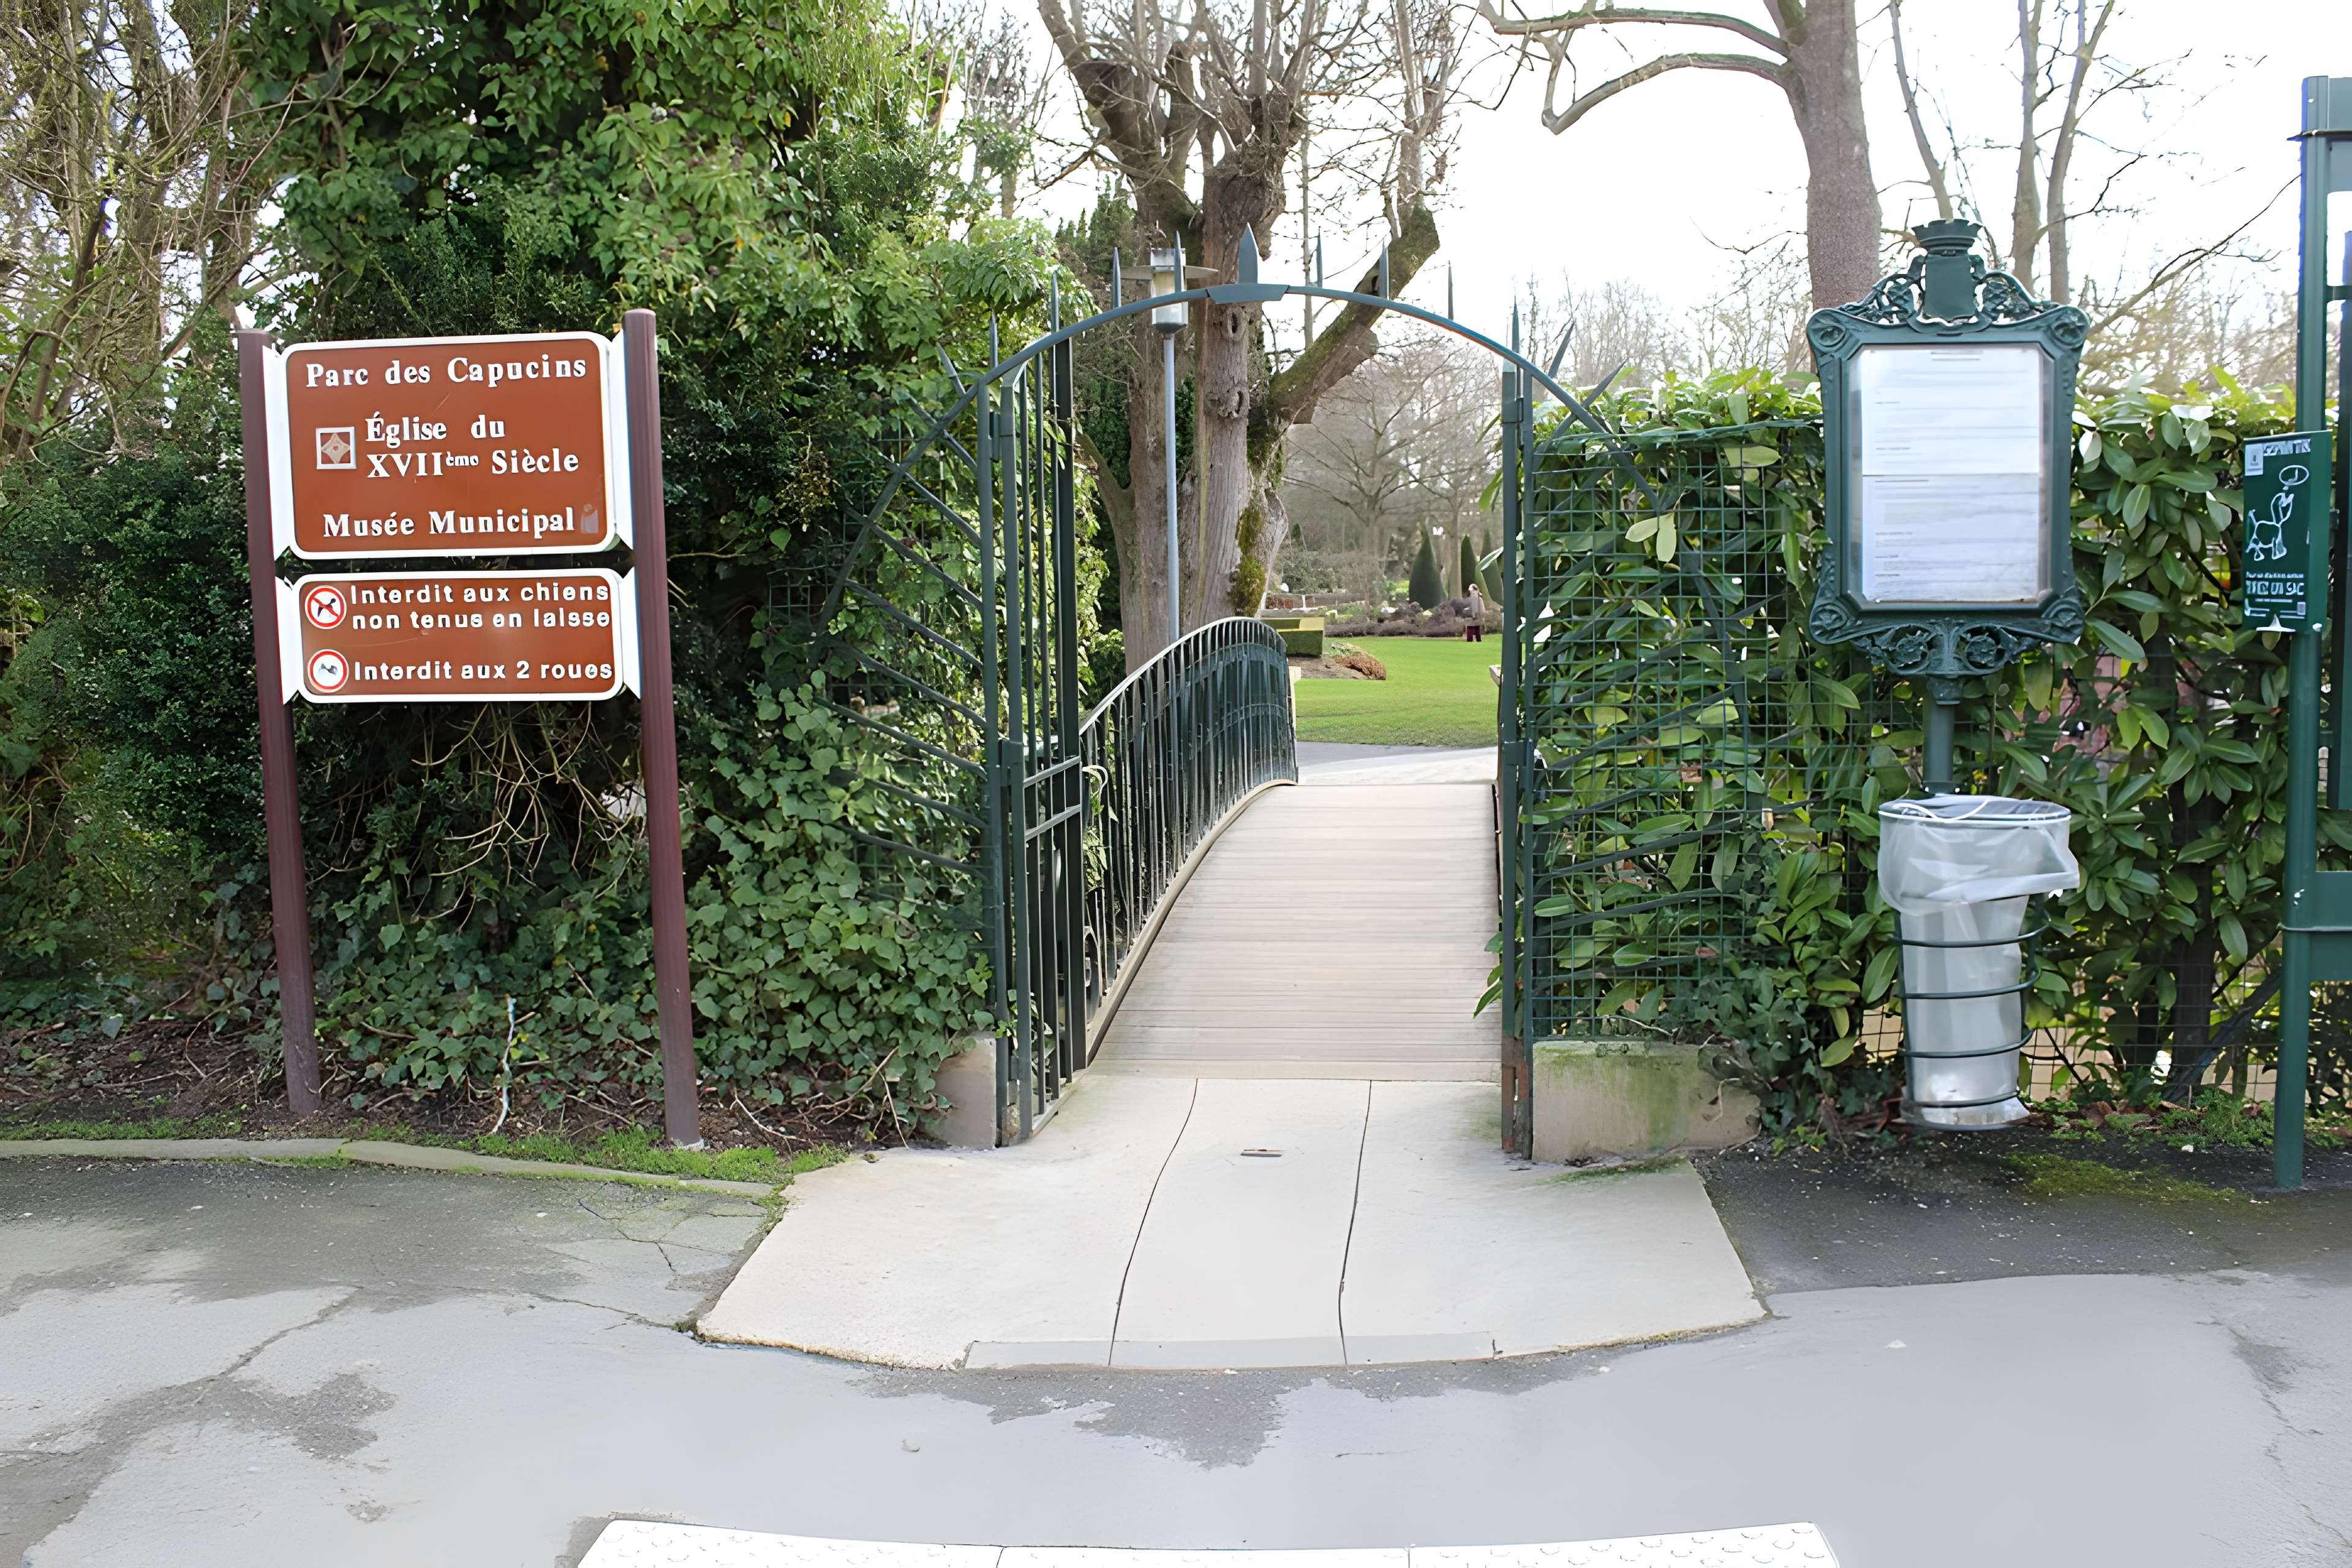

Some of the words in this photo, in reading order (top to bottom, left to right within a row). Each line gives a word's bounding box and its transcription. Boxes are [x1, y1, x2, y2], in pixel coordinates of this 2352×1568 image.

[306, 363, 368, 387] Parc
[385, 360, 431, 384] des
[447, 353, 586, 387] Capucins
[365, 411, 447, 448] Église
[470, 414, 505, 439] du
[492, 448, 579, 475] Siècle
[323, 511, 415, 537] Musée
[428, 507, 575, 539] Municipal
[350, 584, 454, 605] Interdit
[463, 587, 510, 603] aux
[521, 582, 609, 601] chiens
[352, 614, 400, 630] non
[410, 611, 481, 628] tenus
[492, 612, 522, 628] en
[533, 607, 611, 628] laisse
[355, 661, 452, 680] Interdit
[461, 665, 506, 679] aux
[516, 660, 530, 679] 2
[541, 662, 613, 680] roues
